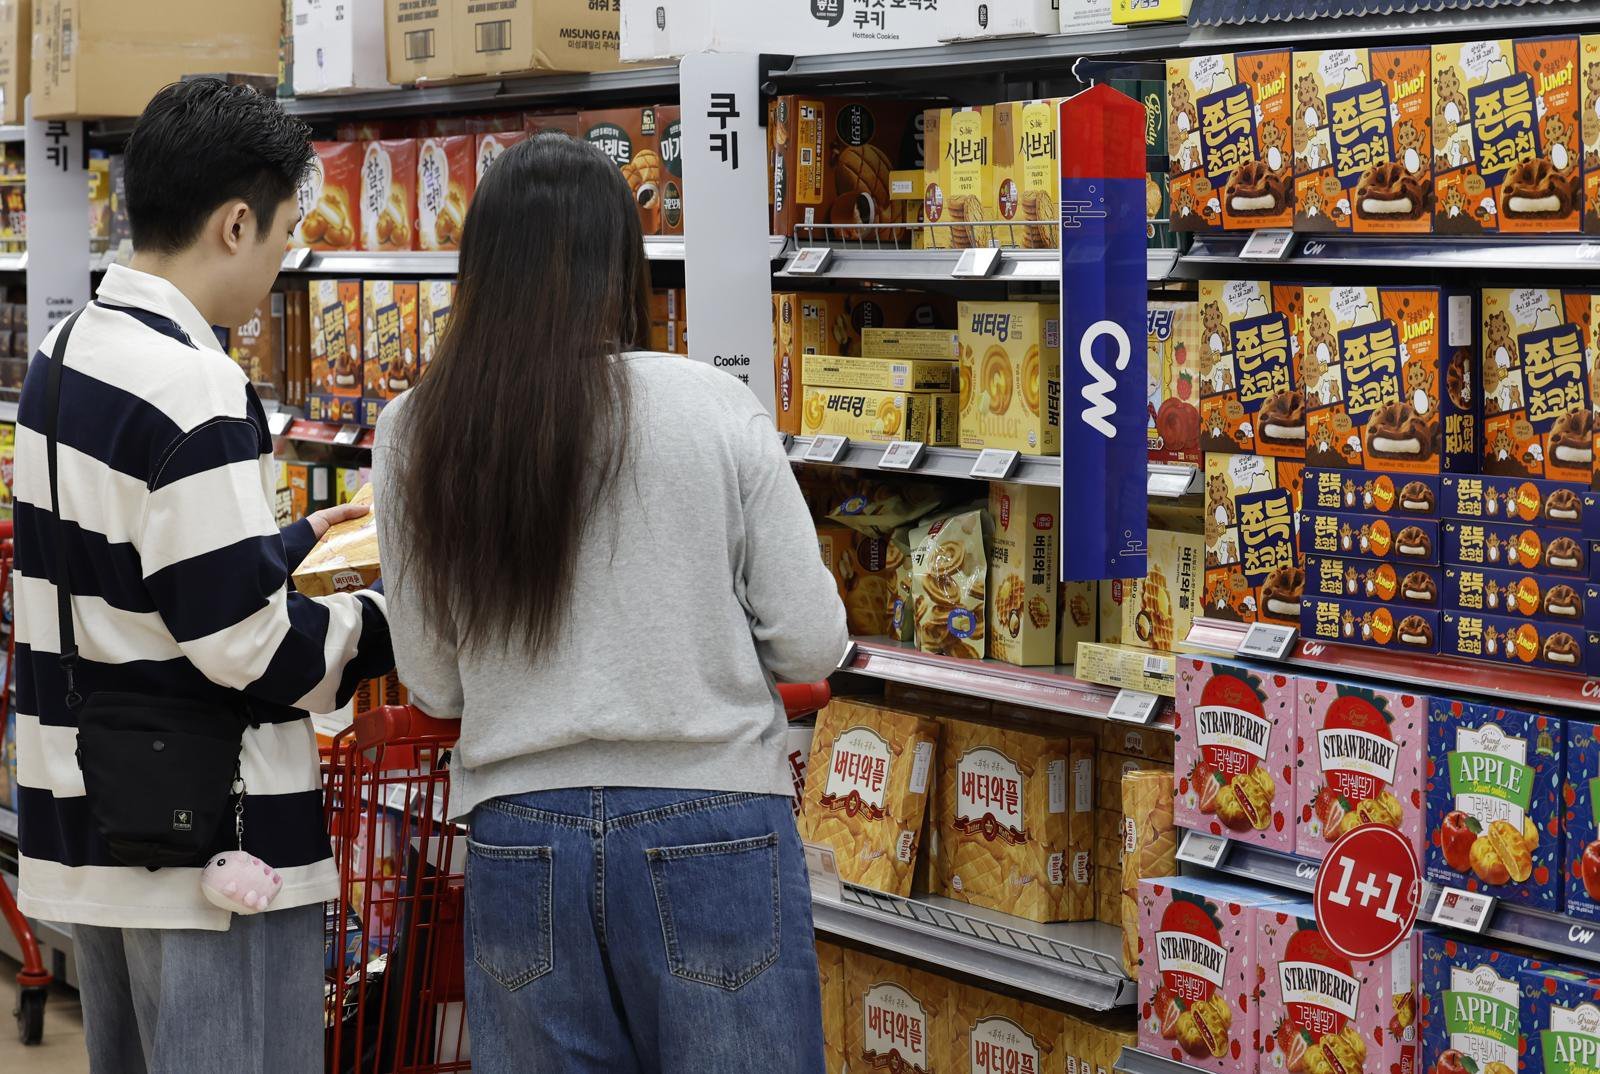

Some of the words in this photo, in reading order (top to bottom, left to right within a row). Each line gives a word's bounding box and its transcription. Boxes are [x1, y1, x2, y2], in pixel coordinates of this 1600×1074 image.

[560, 28, 600, 39] MISUNG
[852, 32, 875, 40] Hotteok
[853, 10, 885, 30] 쿠키
[568, 41, 601, 50] 미성패밀리
[1256, 72, 1287, 104] JUMP!
[1392, 69, 1426, 104] JUMP!
[1538, 60, 1573, 96] JUMP!
[1202, 91, 1252, 147] 쫀득
[1332, 88, 1387, 146] 쫀득
[1474, 81, 1532, 142] 쫀득
[45, 121, 70, 172] 쿠키
[707, 92, 740, 170] 쿠키
[1019, 130, 1056, 162] 사브레
[946, 136, 988, 166] 사브레
[1208, 135, 1254, 178] 초코칩
[1336, 135, 1390, 178] 초코칩
[1480, 130, 1536, 176] 초코칩
[46, 297, 73, 306] Cookie
[972, 312, 1010, 342] 버터링
[1402, 310, 1436, 344] JUMP!
[714, 354, 750, 366] Cookie
[1236, 320, 1288, 372] 쫀득
[1344, 328, 1397, 382] 쫀득
[1524, 332, 1582, 388] 쫀득
[1240, 364, 1290, 402] 초코칩
[1348, 374, 1399, 415] 초코칩
[827, 394, 866, 418] 버터링
[1530, 381, 1585, 422] 초코칩
[1318, 473, 1341, 494] 쫀득
[1457, 479, 1483, 501] 쫀득
[1318, 494, 1340, 508] 초코칩
[1456, 500, 1482, 516] 초코칩
[1240, 497, 1291, 546] 쫀득
[1315, 516, 1338, 538] 쫀득
[1460, 526, 1484, 548] 쫀득
[1244, 541, 1293, 576] 초코칩
[1314, 536, 1338, 552] 초코칩
[1460, 546, 1484, 563] 초코칩
[1032, 535, 1046, 586] 버터와플
[1320, 558, 1344, 581] 쫀득
[334, 574, 360, 586] 버터와플
[1178, 548, 1192, 610] 버터와플
[1320, 580, 1343, 595] 초코칩
[1459, 571, 1484, 594] 쫀득
[1316, 602, 1340, 622] 쫀득
[1458, 593, 1482, 610] 초코칩
[1316, 622, 1339, 638] 초코칩
[1458, 616, 1482, 639] 쫀득
[1457, 638, 1482, 655] 초코칩
[1200, 712, 1268, 748] STRAWBERRY
[1480, 733, 1501, 746] Grand
[1324, 734, 1394, 770] STRAWBERRY
[834, 750, 886, 793] 버터와플
[1460, 756, 1524, 794] APPLE
[961, 772, 1018, 815] 버터와플
[899, 832, 911, 862] 버터와플
[1052, 853, 1061, 884] 버터와플
[1078, 854, 1086, 882] 버터와플
[1328, 856, 1403, 924] 1+1
[1160, 937, 1223, 974] STRAWBERRY
[1284, 968, 1356, 1005] STRAWBERRY
[1475, 974, 1495, 988] Grand
[868, 1004, 922, 1053] 버터와플
[1454, 996, 1518, 1036] APPLE
